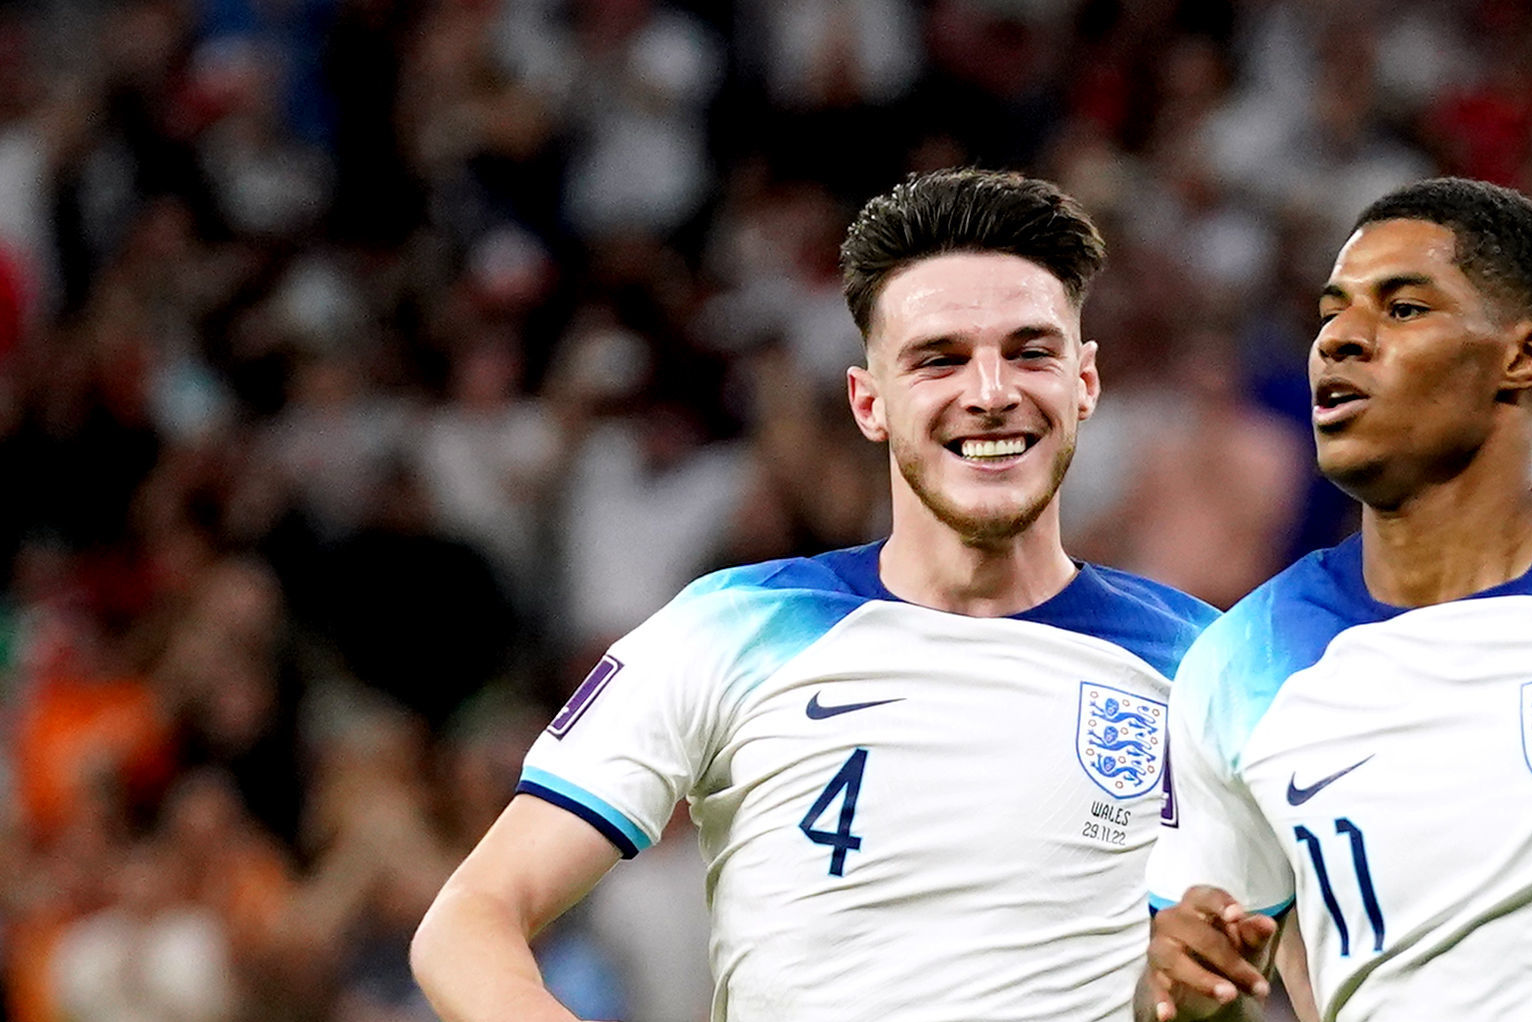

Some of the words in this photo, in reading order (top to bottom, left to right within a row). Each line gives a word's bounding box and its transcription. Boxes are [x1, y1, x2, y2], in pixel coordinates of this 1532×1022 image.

[798, 747, 869, 878] 4
[1083, 821, 1126, 846] 29.11.22
[1091, 800, 1131, 827] WALES
[1293, 816, 1386, 958] 11
